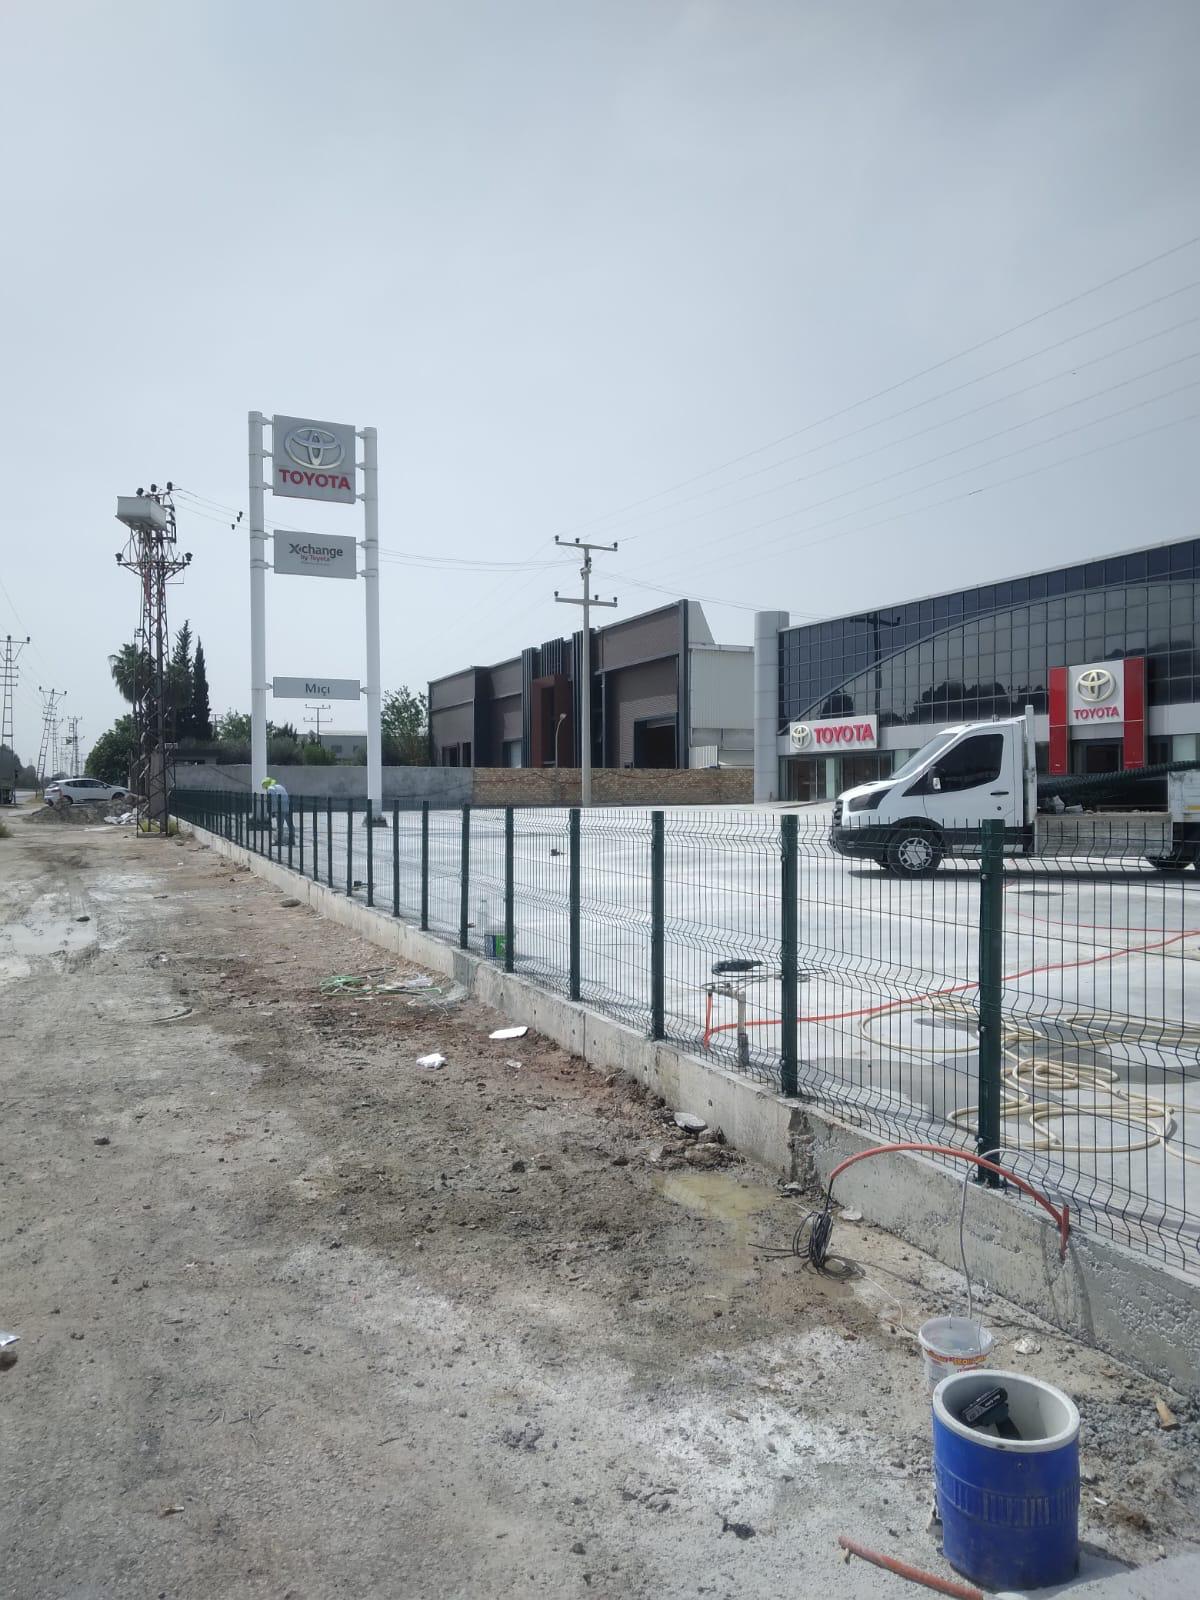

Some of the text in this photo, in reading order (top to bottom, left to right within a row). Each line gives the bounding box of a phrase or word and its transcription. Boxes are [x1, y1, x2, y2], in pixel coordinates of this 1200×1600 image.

[279, 469, 351, 490] TOYOTA
[1073, 706, 1120, 720] TOYOTA
[814, 723, 875, 744] TOYOTA
